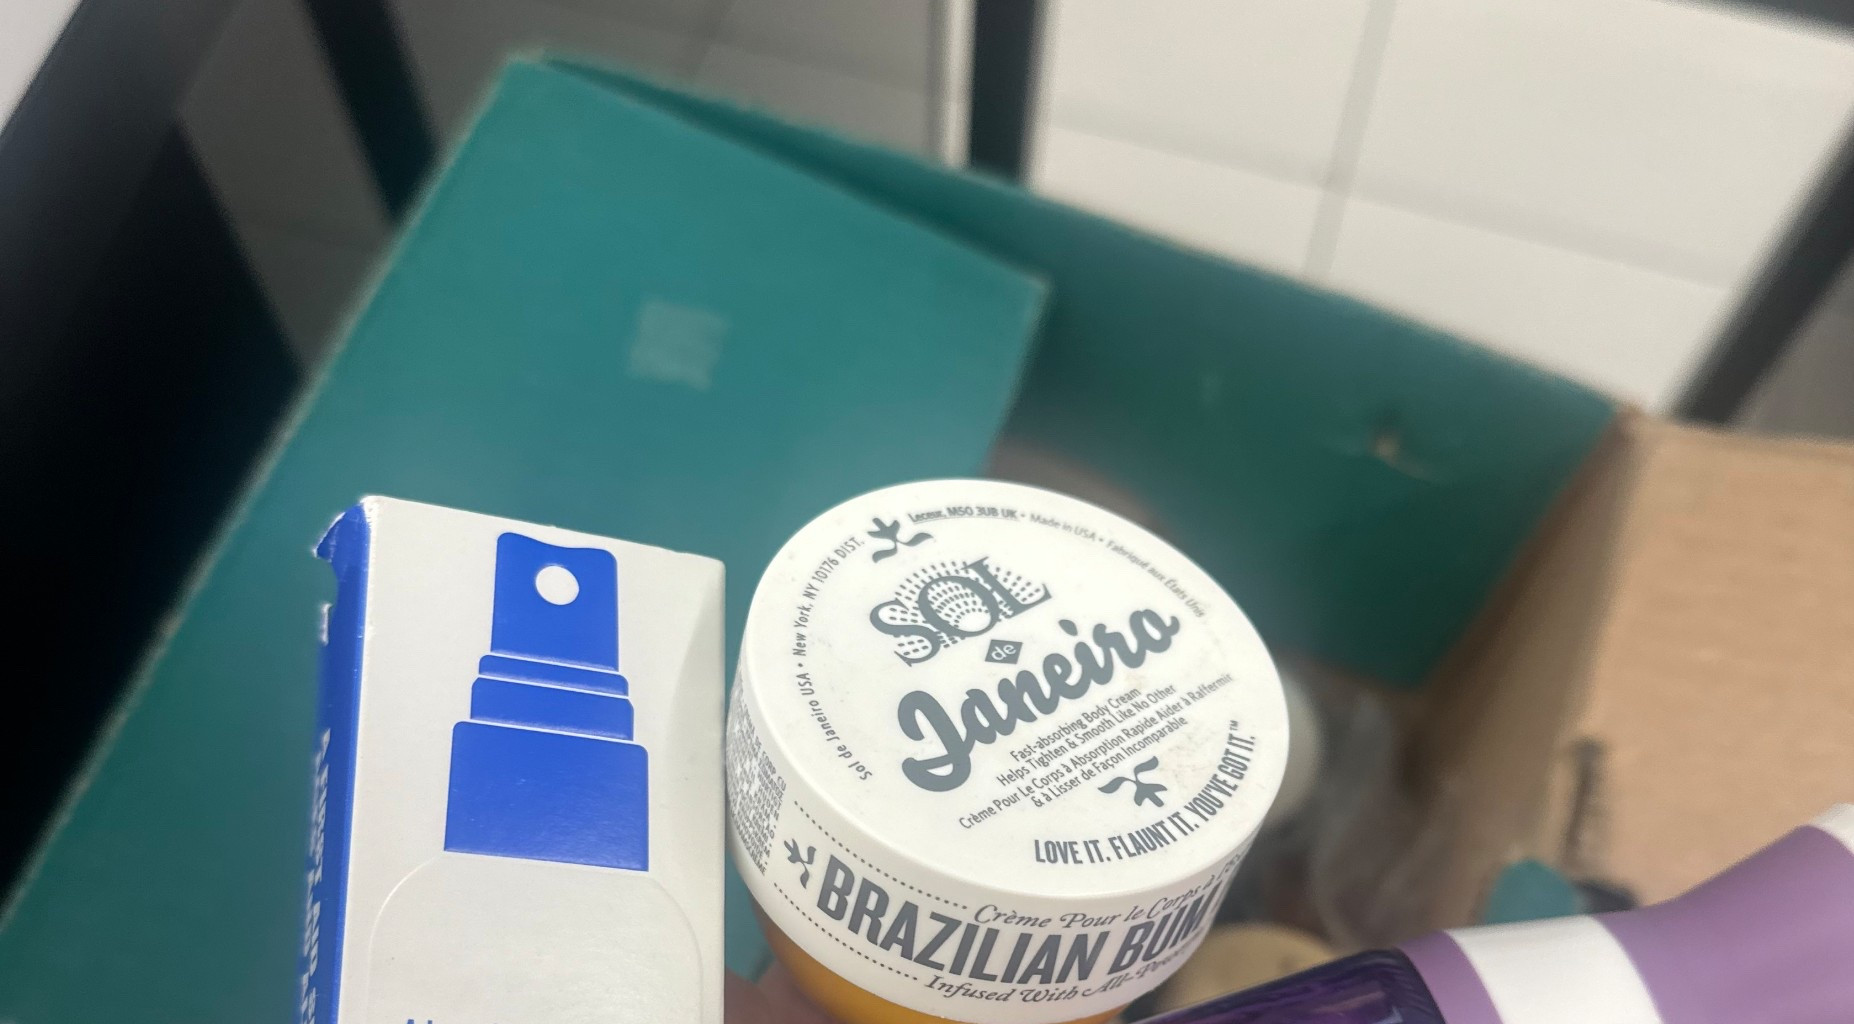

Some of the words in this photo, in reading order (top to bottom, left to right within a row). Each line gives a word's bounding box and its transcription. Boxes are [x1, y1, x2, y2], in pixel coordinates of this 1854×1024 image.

[835, 536, 865, 560] DIST.
[1001, 508, 1017, 519] UK
[1029, 513, 1061, 529] Made
[1062, 521, 1073, 533] in
[1074, 523, 1097, 541] USA
[1147, 567, 1166, 582] aux
[814, 557, 840, 584] 10176
[803, 583, 819, 601] NY
[793, 603, 814, 632] York,
[868, 556, 1053, 667] SOL
[792, 634, 807, 656] New
[991, 642, 1017, 661] de
[796, 672, 815, 696] USA
[897, 608, 1182, 793] Janeiro
[811, 700, 841, 744] Janeiro
[996, 764, 1031, 790] Helps
[1025, 742, 1070, 774] Tighten
[1066, 736, 1079, 751] &
[1078, 715, 1115, 746] Smooth
[1112, 703, 1137, 727] Like
[1133, 696, 1151, 716] No
[1148, 683, 1178, 707] Other
[1010, 714, 1085, 763] Fast-absorbing
[1081, 702, 1110, 726] Body
[1107, 687, 1142, 711] Cream
[838, 744, 853, 768] de
[850, 760, 872, 781] Sol
[958, 805, 997, 831] Crème
[992, 788, 1028, 813] Pour
[1020, 781, 1036, 800] Le
[1031, 767, 1066, 795] Corps
[1061, 759, 1074, 775] à
[1069, 731, 1125, 770] Absorption
[1120, 714, 1160, 749] Rapide
[1156, 702, 1185, 726] Aider
[1180, 695, 1193, 711] à
[1031, 794, 1045, 810] &
[1041, 790, 1052, 806] à
[1048, 774, 1083, 800] Lisser
[1080, 765, 1097, 782] de
[1091, 748, 1126, 778] Façon
[1122, 715, 1190, 759] Incomparable
[1217, 748, 1252, 781] GOT
[1183, 772, 1240, 823] YOU'VE
[1167, 811, 1201, 837] IT.
[1034, 838, 1083, 865] LOVE
[1083, 839, 1112, 864] IT.
[1107, 819, 1178, 861] FLAUNT
[816, 854, 1111, 986] BRAZILIAN
[973, 904, 1053, 929] Crème
[1059, 912, 1122, 929] Pour
[1123, 905, 1145, 922] le
[1146, 885, 1202, 919] Corps
[923, 974, 1017, 1004] Infused
[1018, 985, 1079, 1004] With
